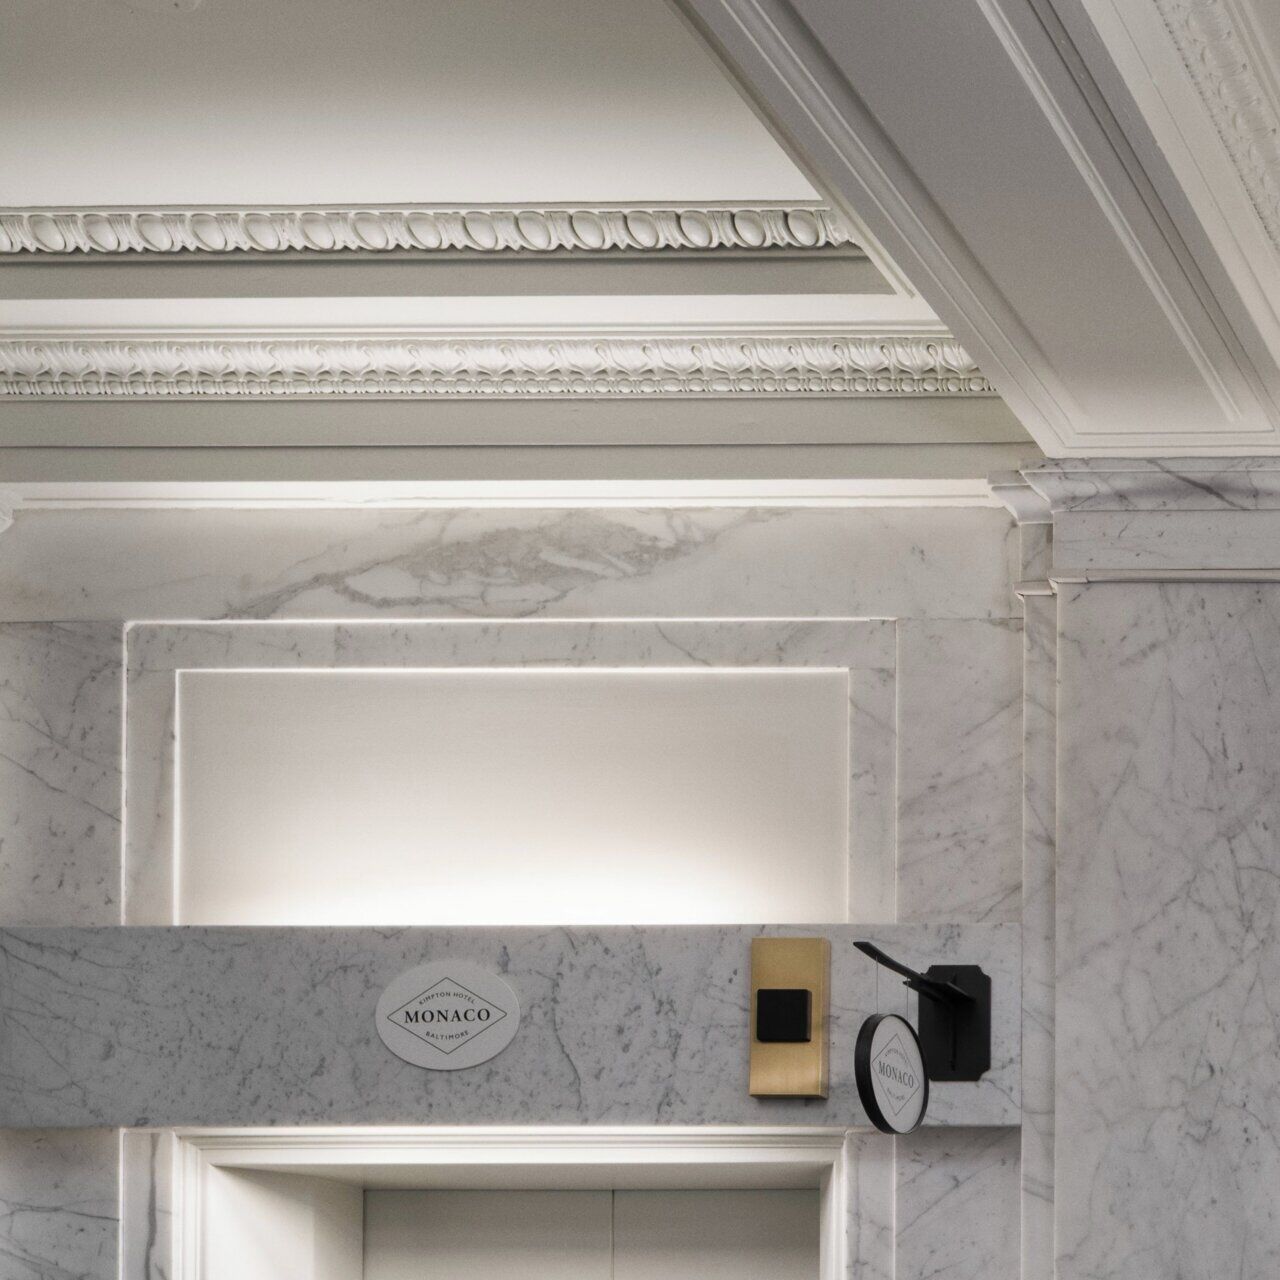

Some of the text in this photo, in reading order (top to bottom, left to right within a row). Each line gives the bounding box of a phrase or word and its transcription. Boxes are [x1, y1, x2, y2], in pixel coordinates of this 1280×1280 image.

[419, 992, 476, 1004] KIMPTON HOTEL
[404, 1008, 491, 1024] MONACO
[425, 1030, 469, 1040] BALTIMORE
[878, 1060, 914, 1089] MONACO
